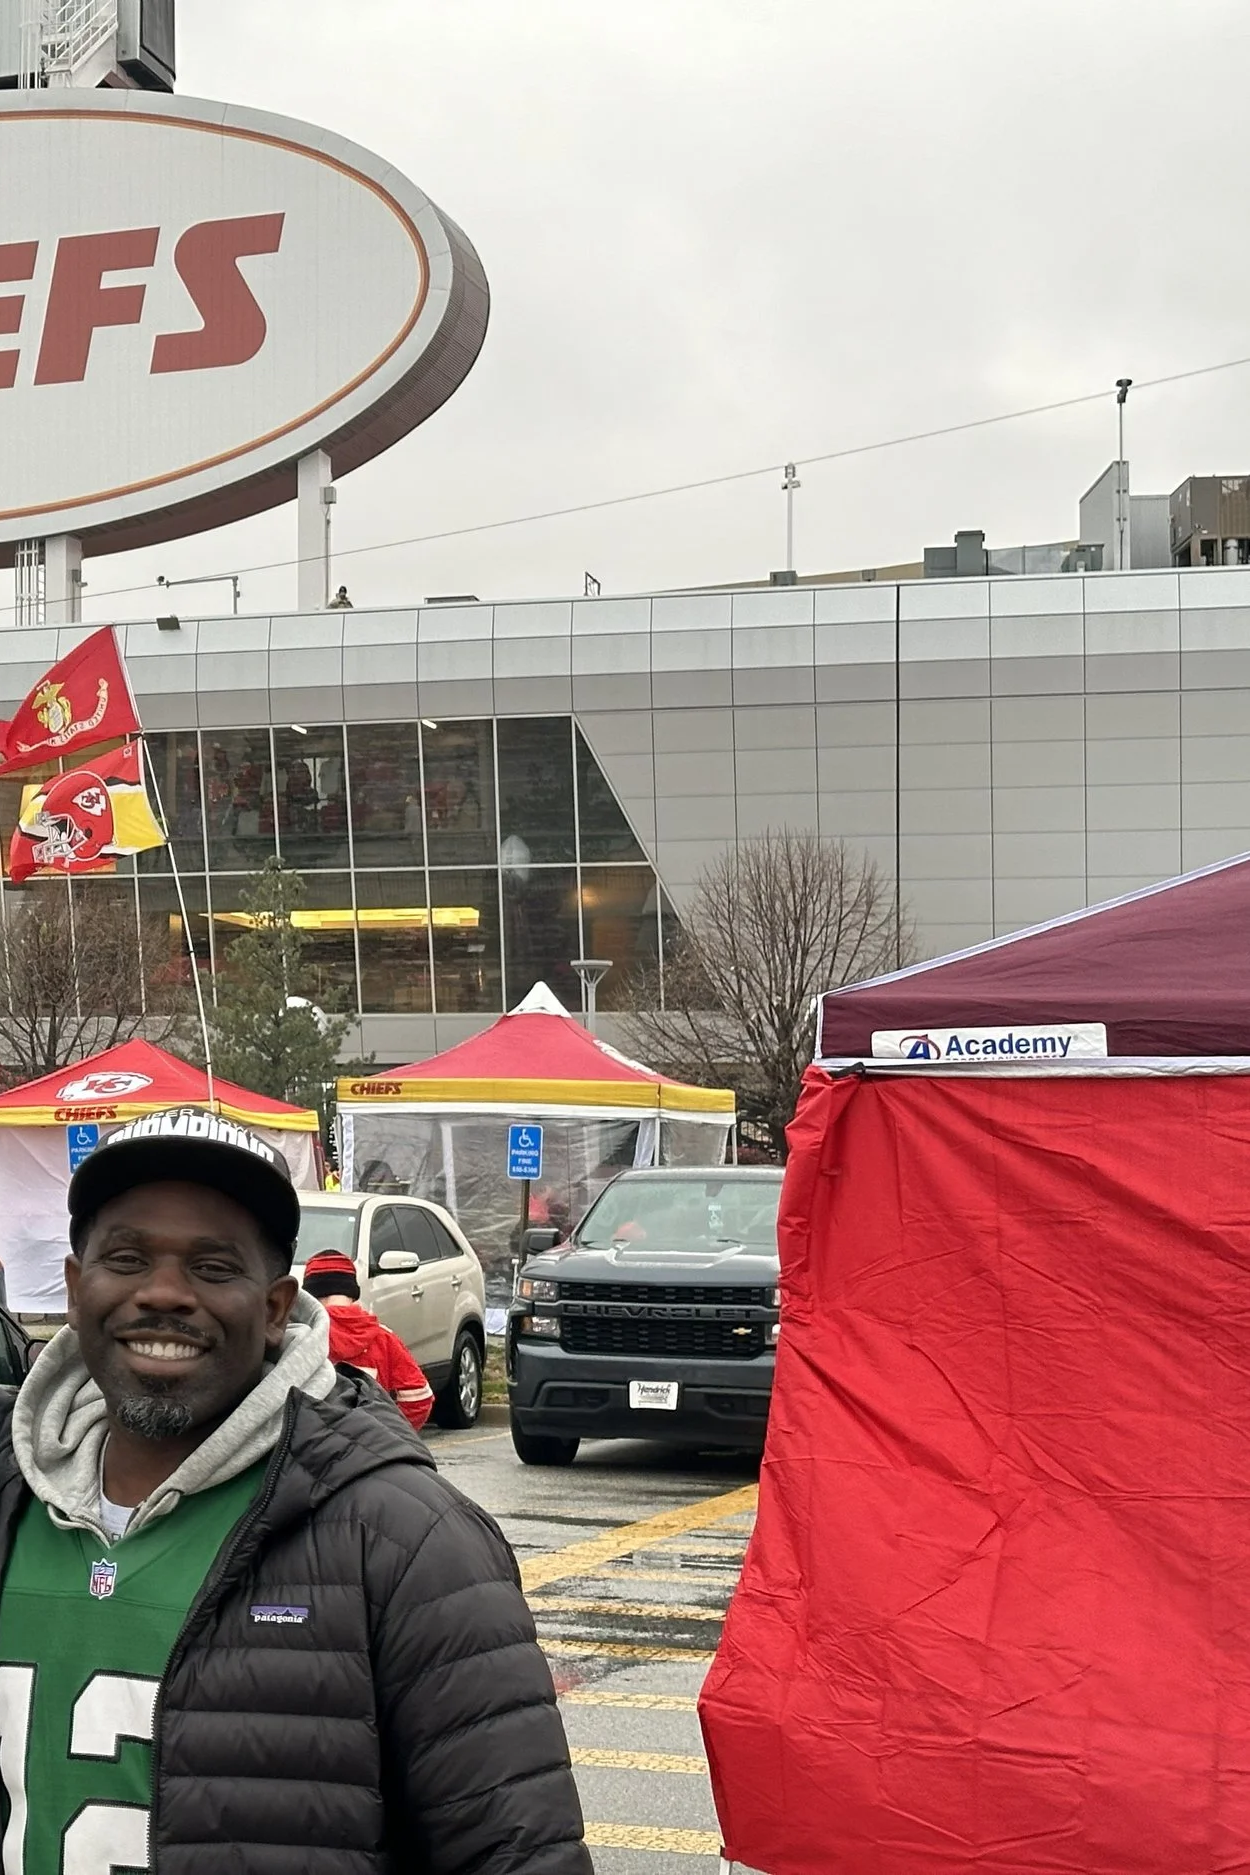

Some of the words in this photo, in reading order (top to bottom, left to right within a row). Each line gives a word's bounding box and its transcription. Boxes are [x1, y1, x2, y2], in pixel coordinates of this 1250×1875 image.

[945, 1033, 1072, 1058] Academy
[351, 1082, 403, 1096] CHIEFS
[54, 1105, 118, 1121] CHIEFS
[563, 1303, 759, 1321] CHEVROLET
[92, 1575, 111, 1595] NFL
[254, 1614, 303, 1624] patagonia
